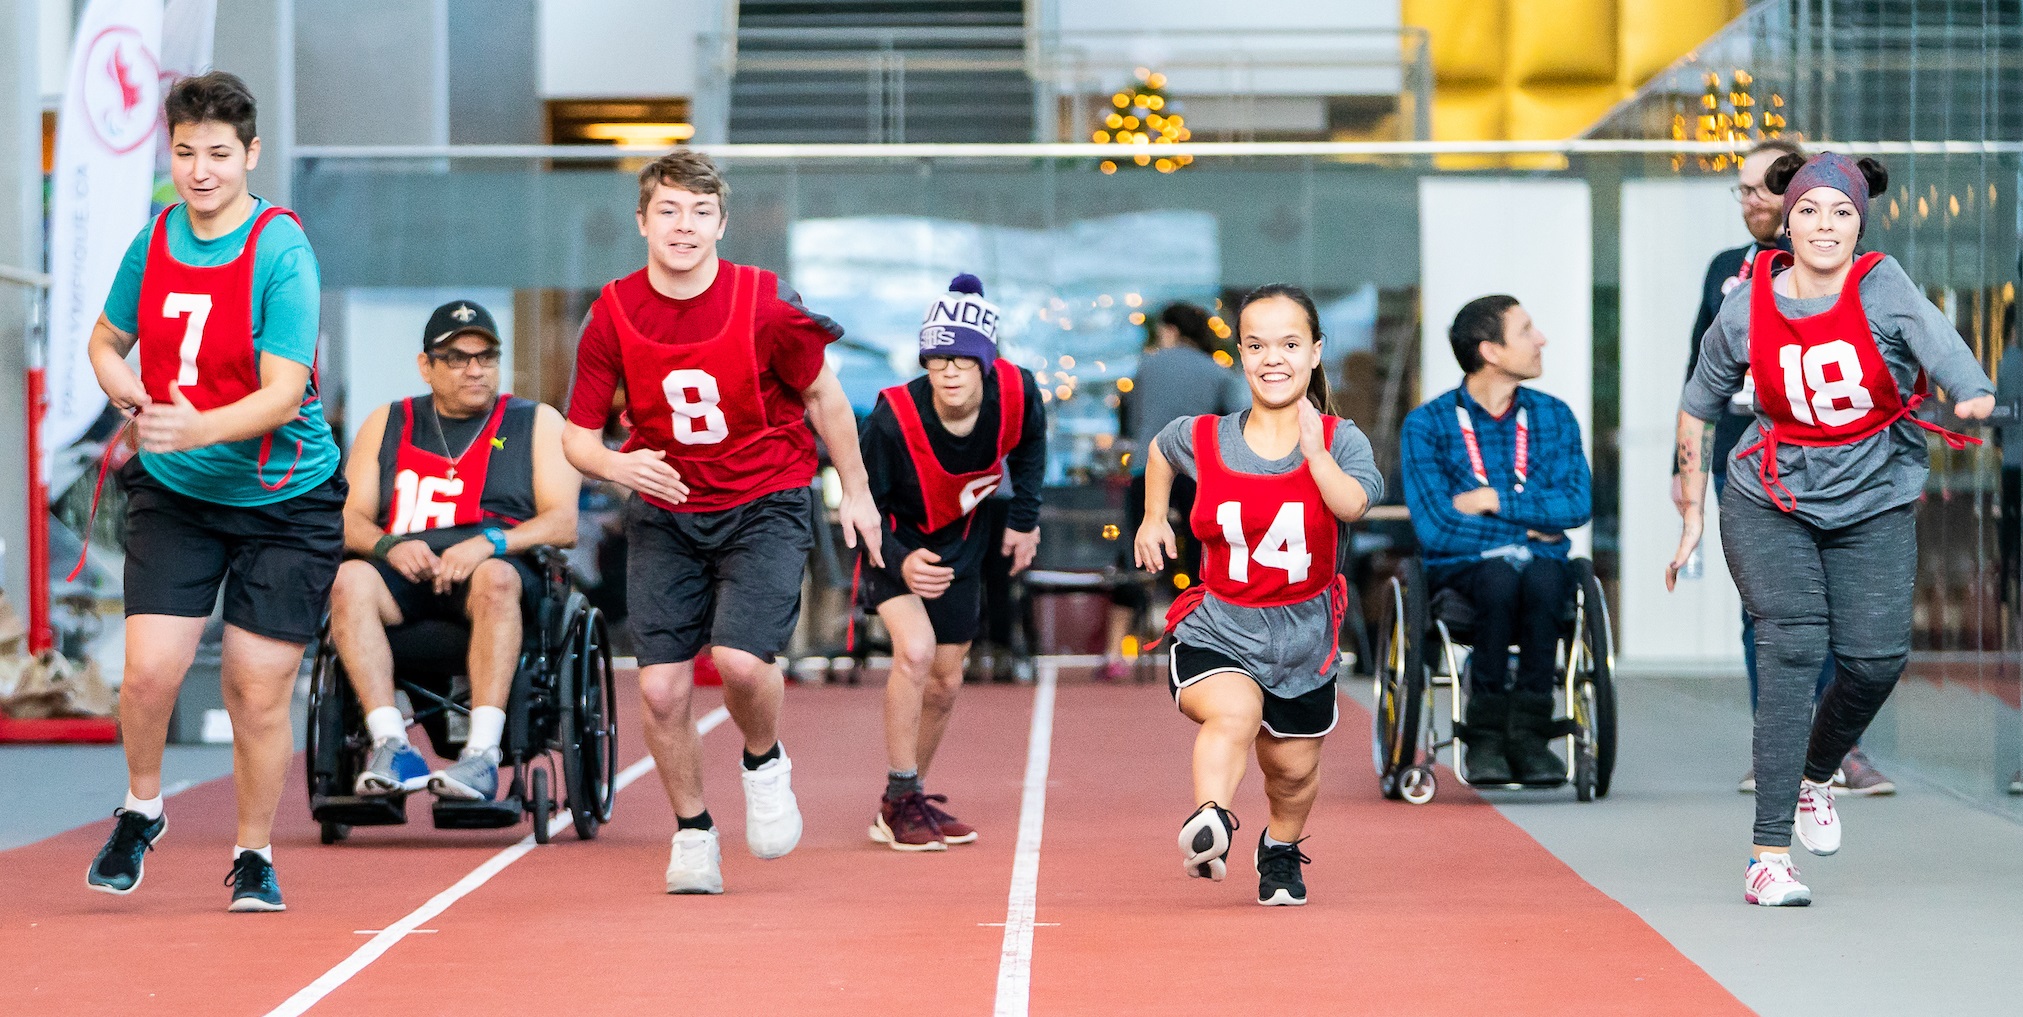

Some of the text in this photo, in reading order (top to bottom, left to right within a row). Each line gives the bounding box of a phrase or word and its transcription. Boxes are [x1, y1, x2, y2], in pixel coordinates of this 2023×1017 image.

[163, 292, 213, 386] 7
[662, 368, 730, 445] 8
[1779, 340, 1874, 427] 18
[391, 468, 464, 536] 16
[1216, 501, 1312, 584] 14
